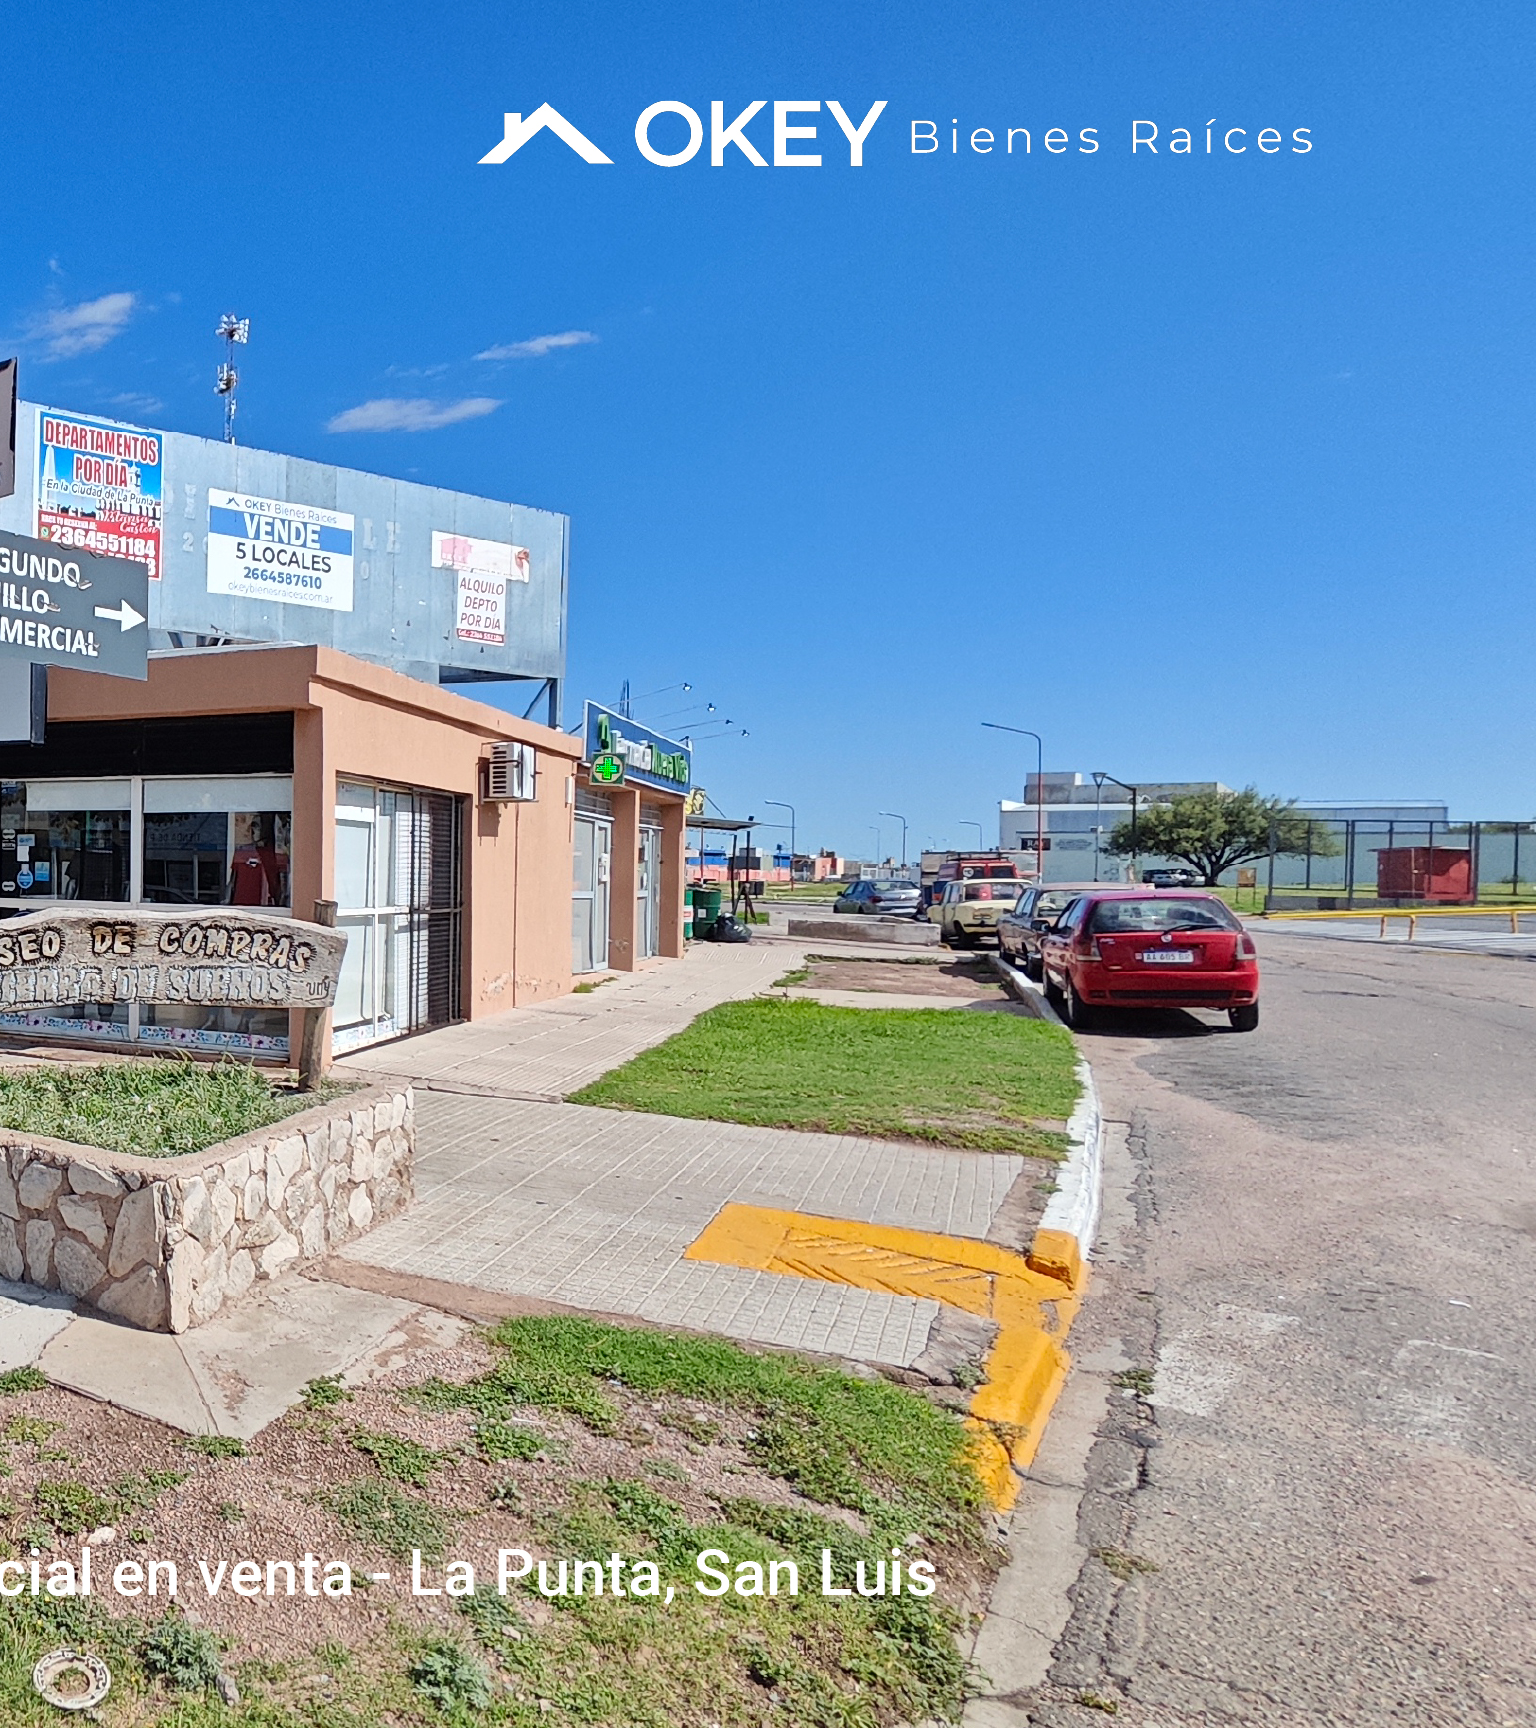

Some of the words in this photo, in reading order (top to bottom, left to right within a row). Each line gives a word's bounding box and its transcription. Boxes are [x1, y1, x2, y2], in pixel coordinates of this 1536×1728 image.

[45, 419, 158, 464] DEPARTAMENTOS
[75, 456, 102, 484] POR
[105, 459, 128, 488] DÍA
[46, 478, 59, 489] En
[61, 481, 69, 492] la
[71, 483, 102, 498] Ciudad
[104, 489, 115, 500] de
[117, 490, 128, 502] La
[245, 499, 272, 512] OKEY
[274, 504, 306, 519] Bienes
[50, 525, 157, 557] 2364551184
[243, 512, 321, 549] VENDE
[235, 542, 246, 559] 5
[252, 544, 332, 573] LOCALES
[243, 566, 322, 589] 2664587610
[459, 577, 504, 596] ALQUILO
[464, 596, 498, 612] DEPTO
[460, 612, 482, 628] POR
[91, 924, 132, 954] DE
[160, 925, 311, 973] COMPRAS
[114, 967, 157, 1000] DE
